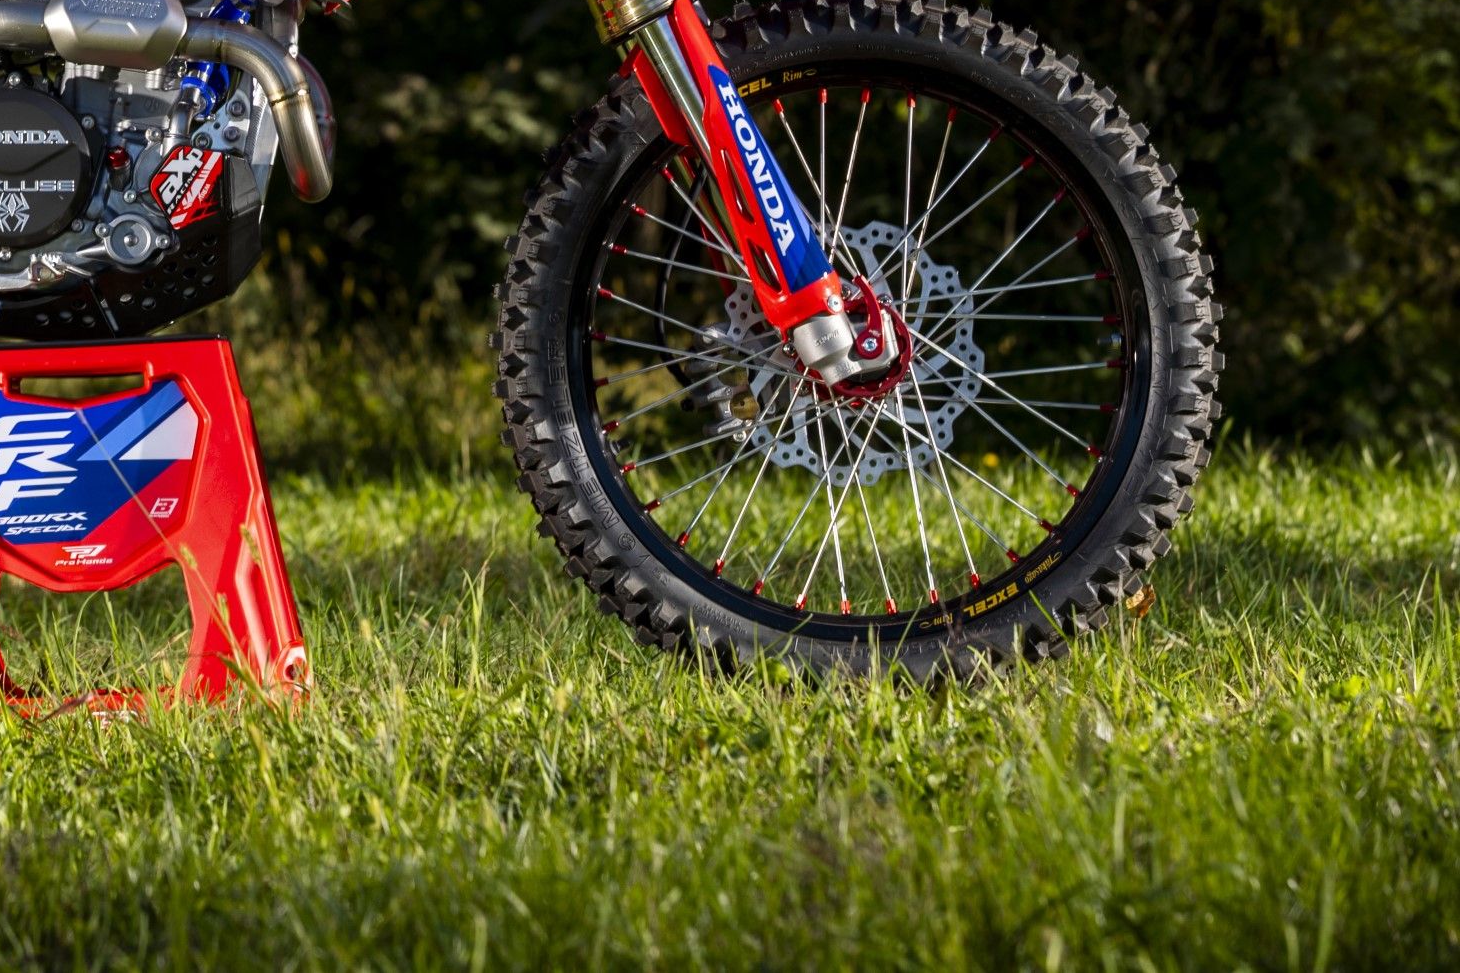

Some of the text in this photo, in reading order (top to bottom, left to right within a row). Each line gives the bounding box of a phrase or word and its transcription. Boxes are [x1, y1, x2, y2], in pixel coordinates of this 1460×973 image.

[736, 71, 803, 98] CEL Rim
[718, 81, 796, 257] HONDA
[549, 337, 621, 530] METZELER
[3, 523, 87, 536] SPECIAL
[1024, 552, 1060, 584] Takasago
[963, 582, 1019, 618] EXCEL
